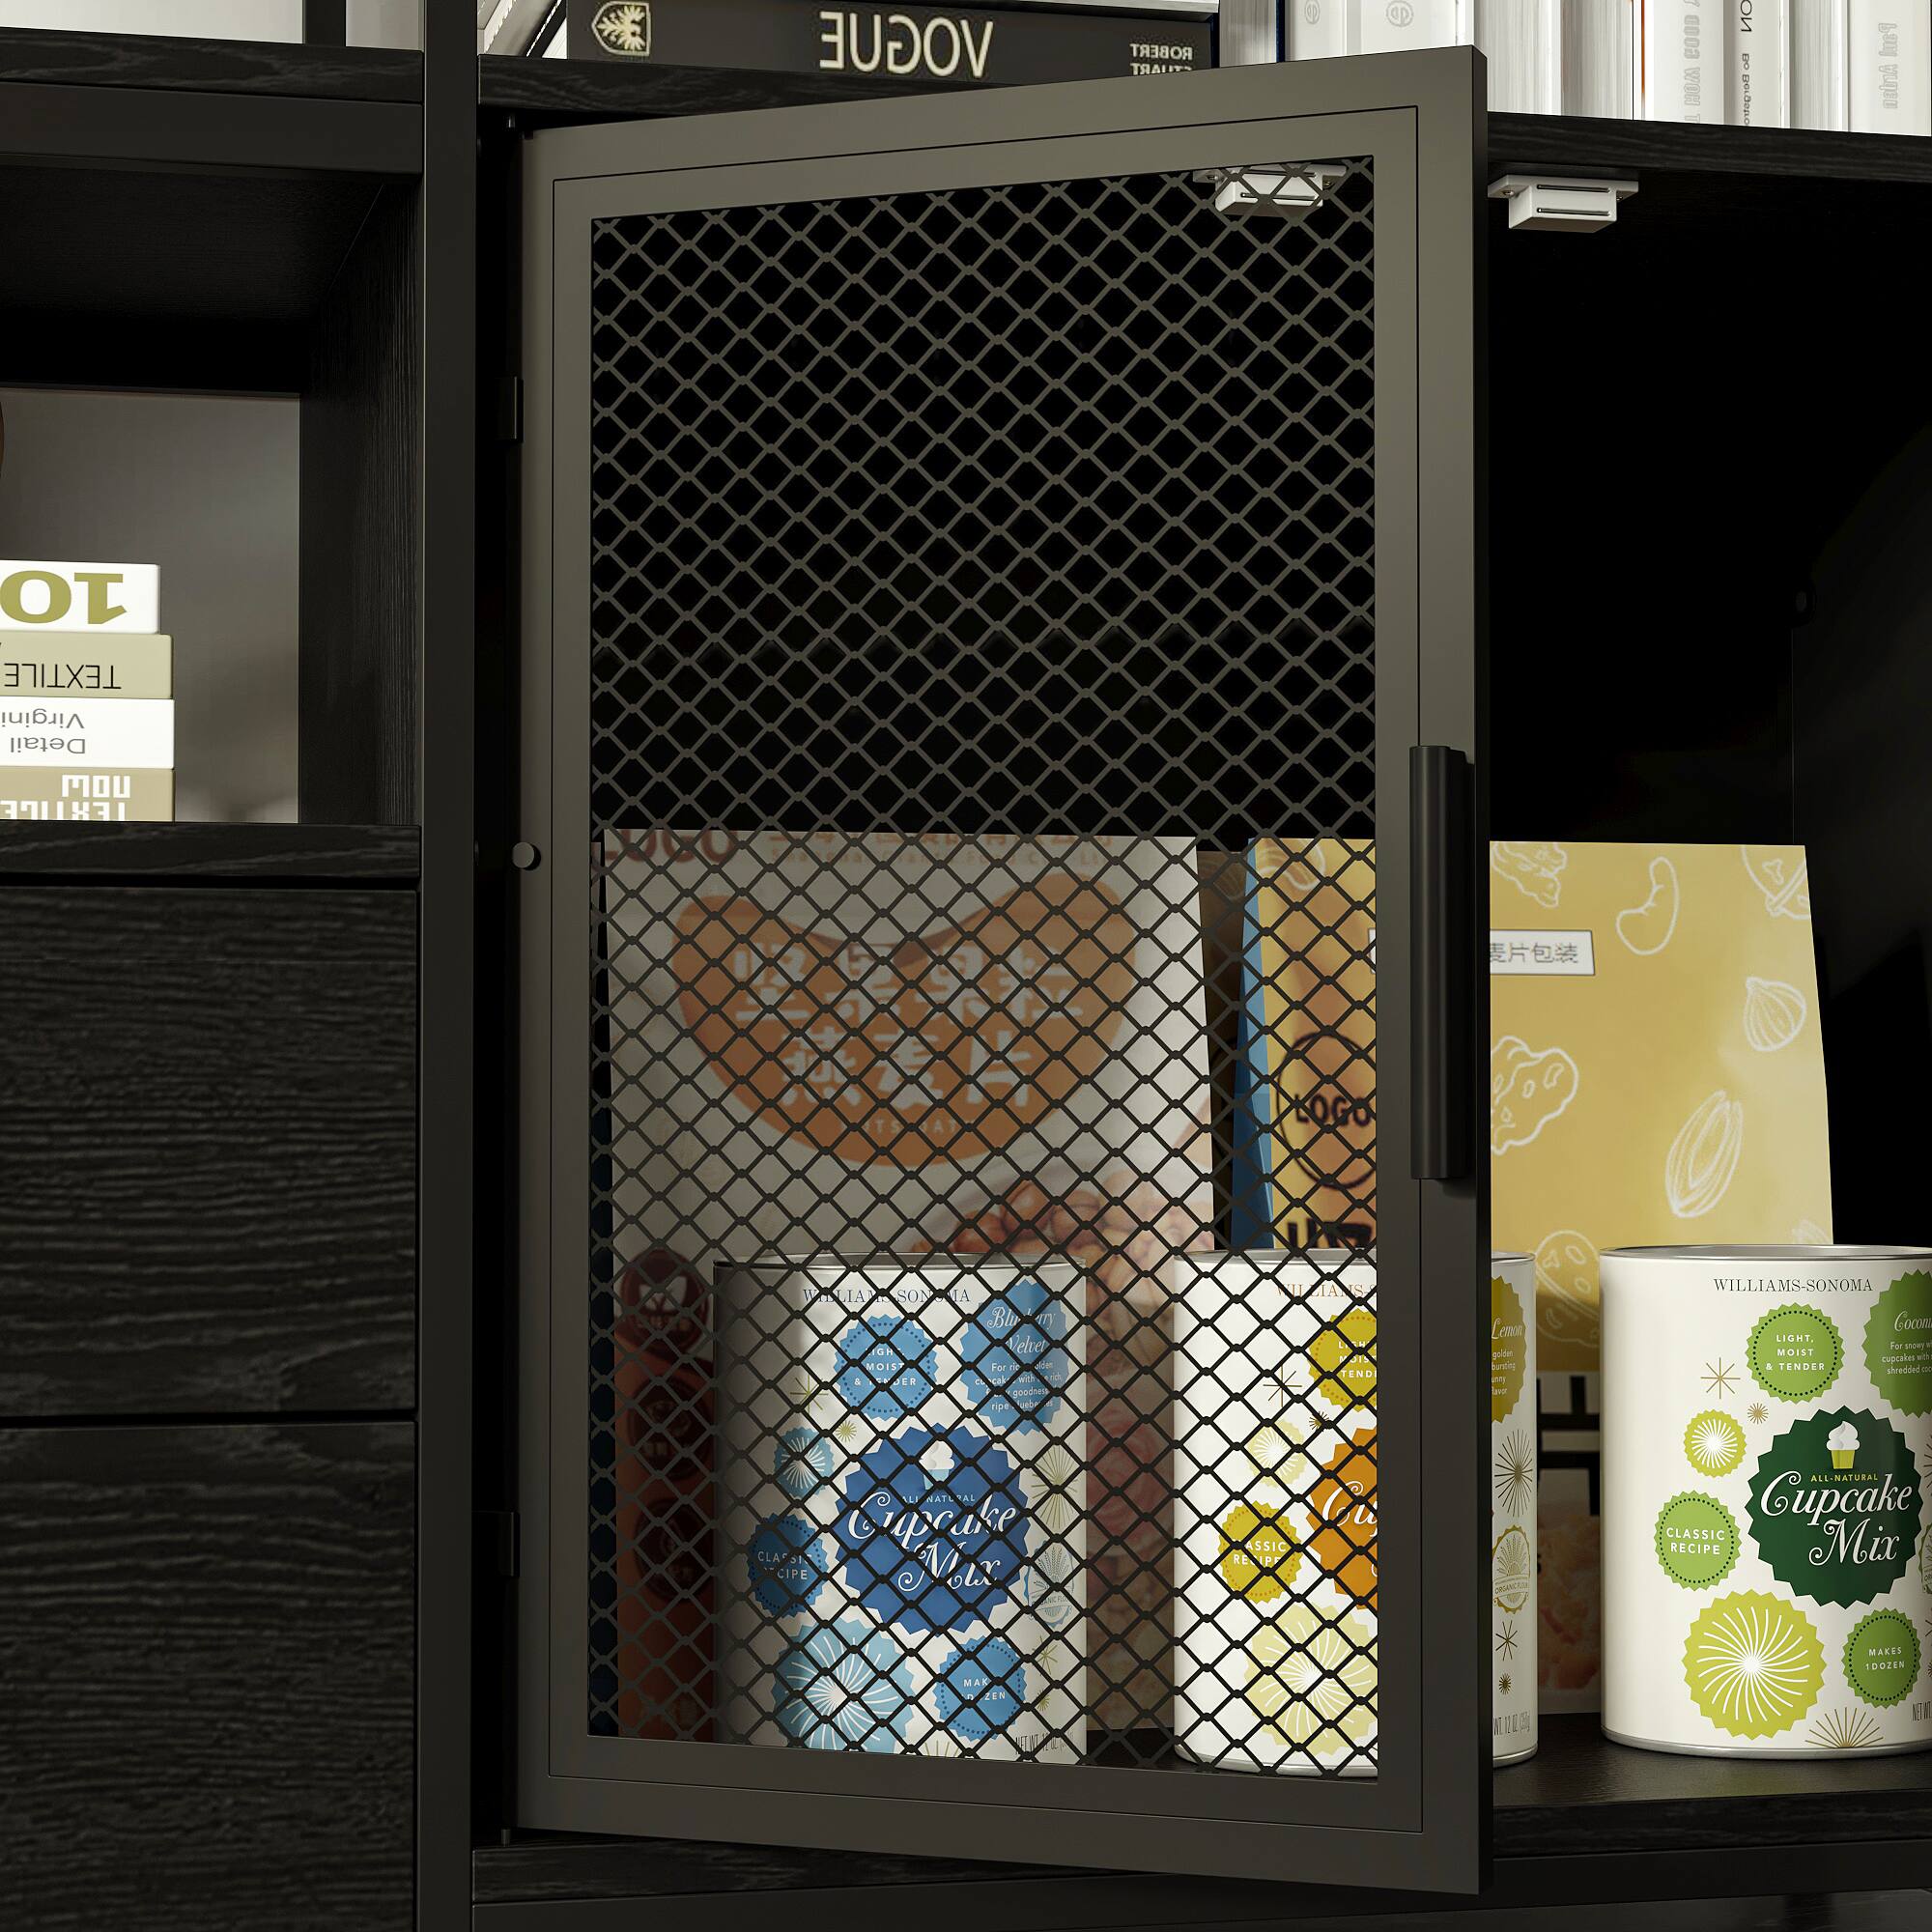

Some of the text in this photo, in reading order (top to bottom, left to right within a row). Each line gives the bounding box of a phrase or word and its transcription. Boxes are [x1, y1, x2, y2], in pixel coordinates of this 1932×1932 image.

[0, 570, 127, 624] 10
[4, 664, 122, 689] TEXTILE
[1, 708, 85, 728] Virgini
[10, 737, 86, 754] Detail
[61, 774, 131, 798] NOW
[1294, 1094, 1371, 1127] LOGO
[1714, 1278, 1873, 1293] WILLIAMS-SONOMA
[1492, 1318, 1522, 1340] Lemon
[1776, 1335, 1814, 1344] LIGHT,
[1889, 1342, 1904, 1350] For
[1905, 1342, 1925, 1351] snowy
[1882, 1353, 1916, 1365] cupcakes
[991, 1363, 1007, 1372] For
[1033, 1361, 1053, 1371] olden
[1779, 1362, 1826, 1371] TENDER
[1887, 1364, 1920, 1375] shredded
[854, 1378, 862, 1386] &
[991, 1403, 1009, 1413] ripe
[1810, 1473, 1879, 1483] ALL-NATURAL
[901, 1493, 976, 1504] ALLNATURAL
[1760, 1470, 1913, 1526] Cupcake
[847, 1490, 1017, 1551] Cupcake
[1666, 1527, 1725, 1541] CLASSIC
[1670, 1543, 1720, 1555] RECIPE
[1808, 1519, 1900, 1566] Mix
[763, 1567, 808, 1580] CIPE
[1868, 1646, 1903, 1656] MAKES
